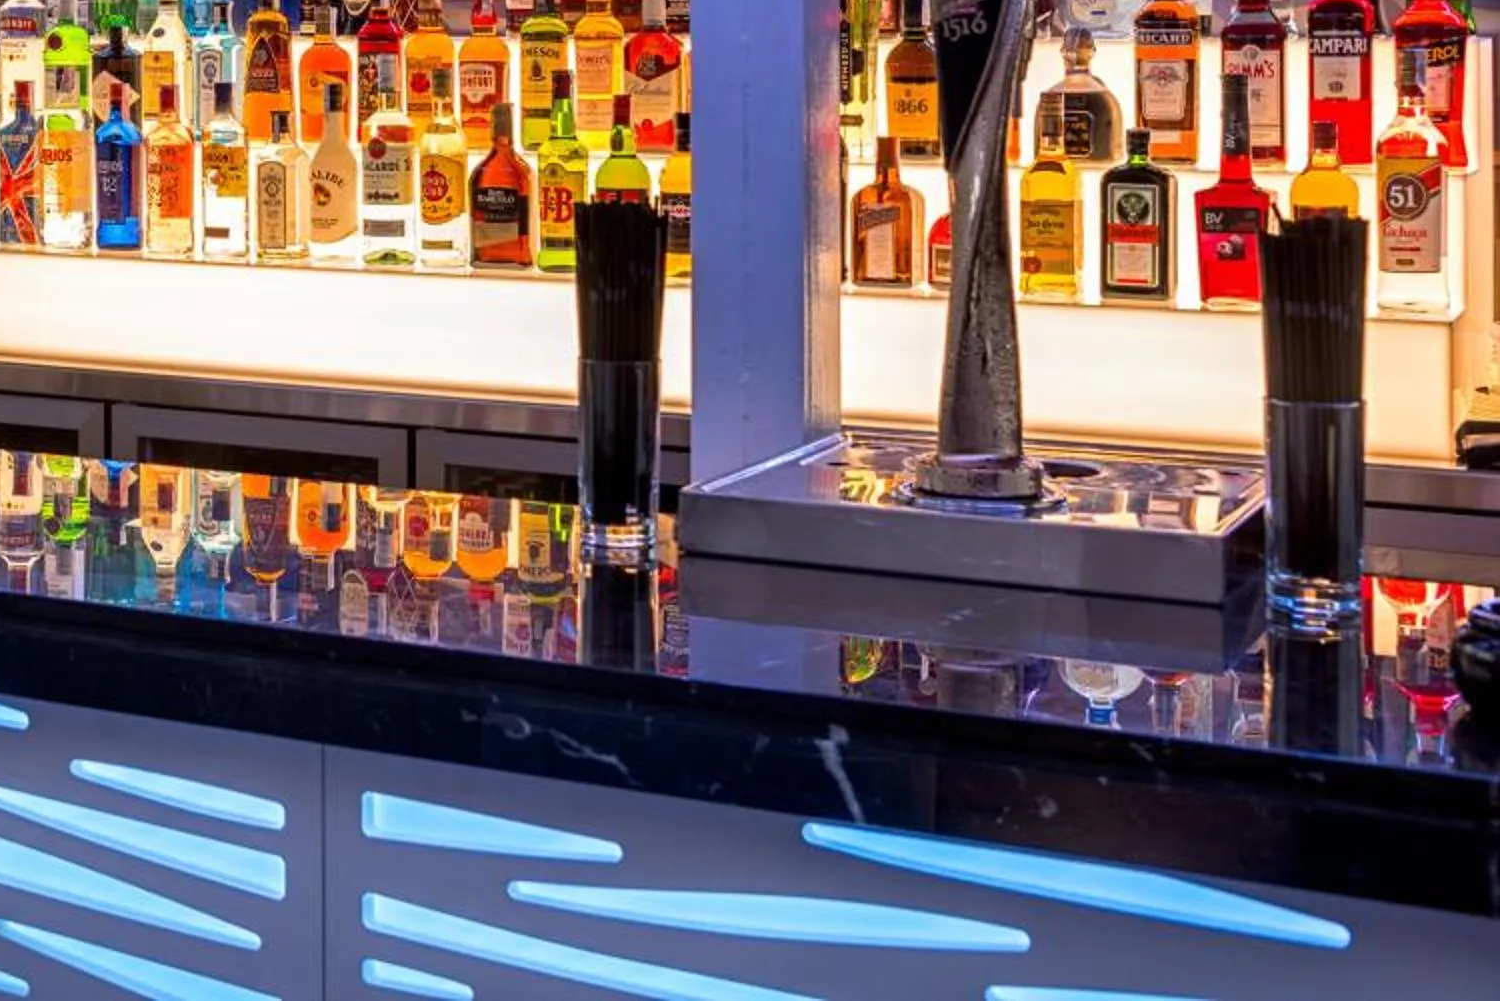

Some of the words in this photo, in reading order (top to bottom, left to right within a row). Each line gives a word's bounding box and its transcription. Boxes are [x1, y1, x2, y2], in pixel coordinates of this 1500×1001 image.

[943, 10, 988, 43] 1516
[1427, 44, 1459, 62] EROL
[311, 169, 344, 187] ALIBU
[1389, 185, 1417, 208] 51
